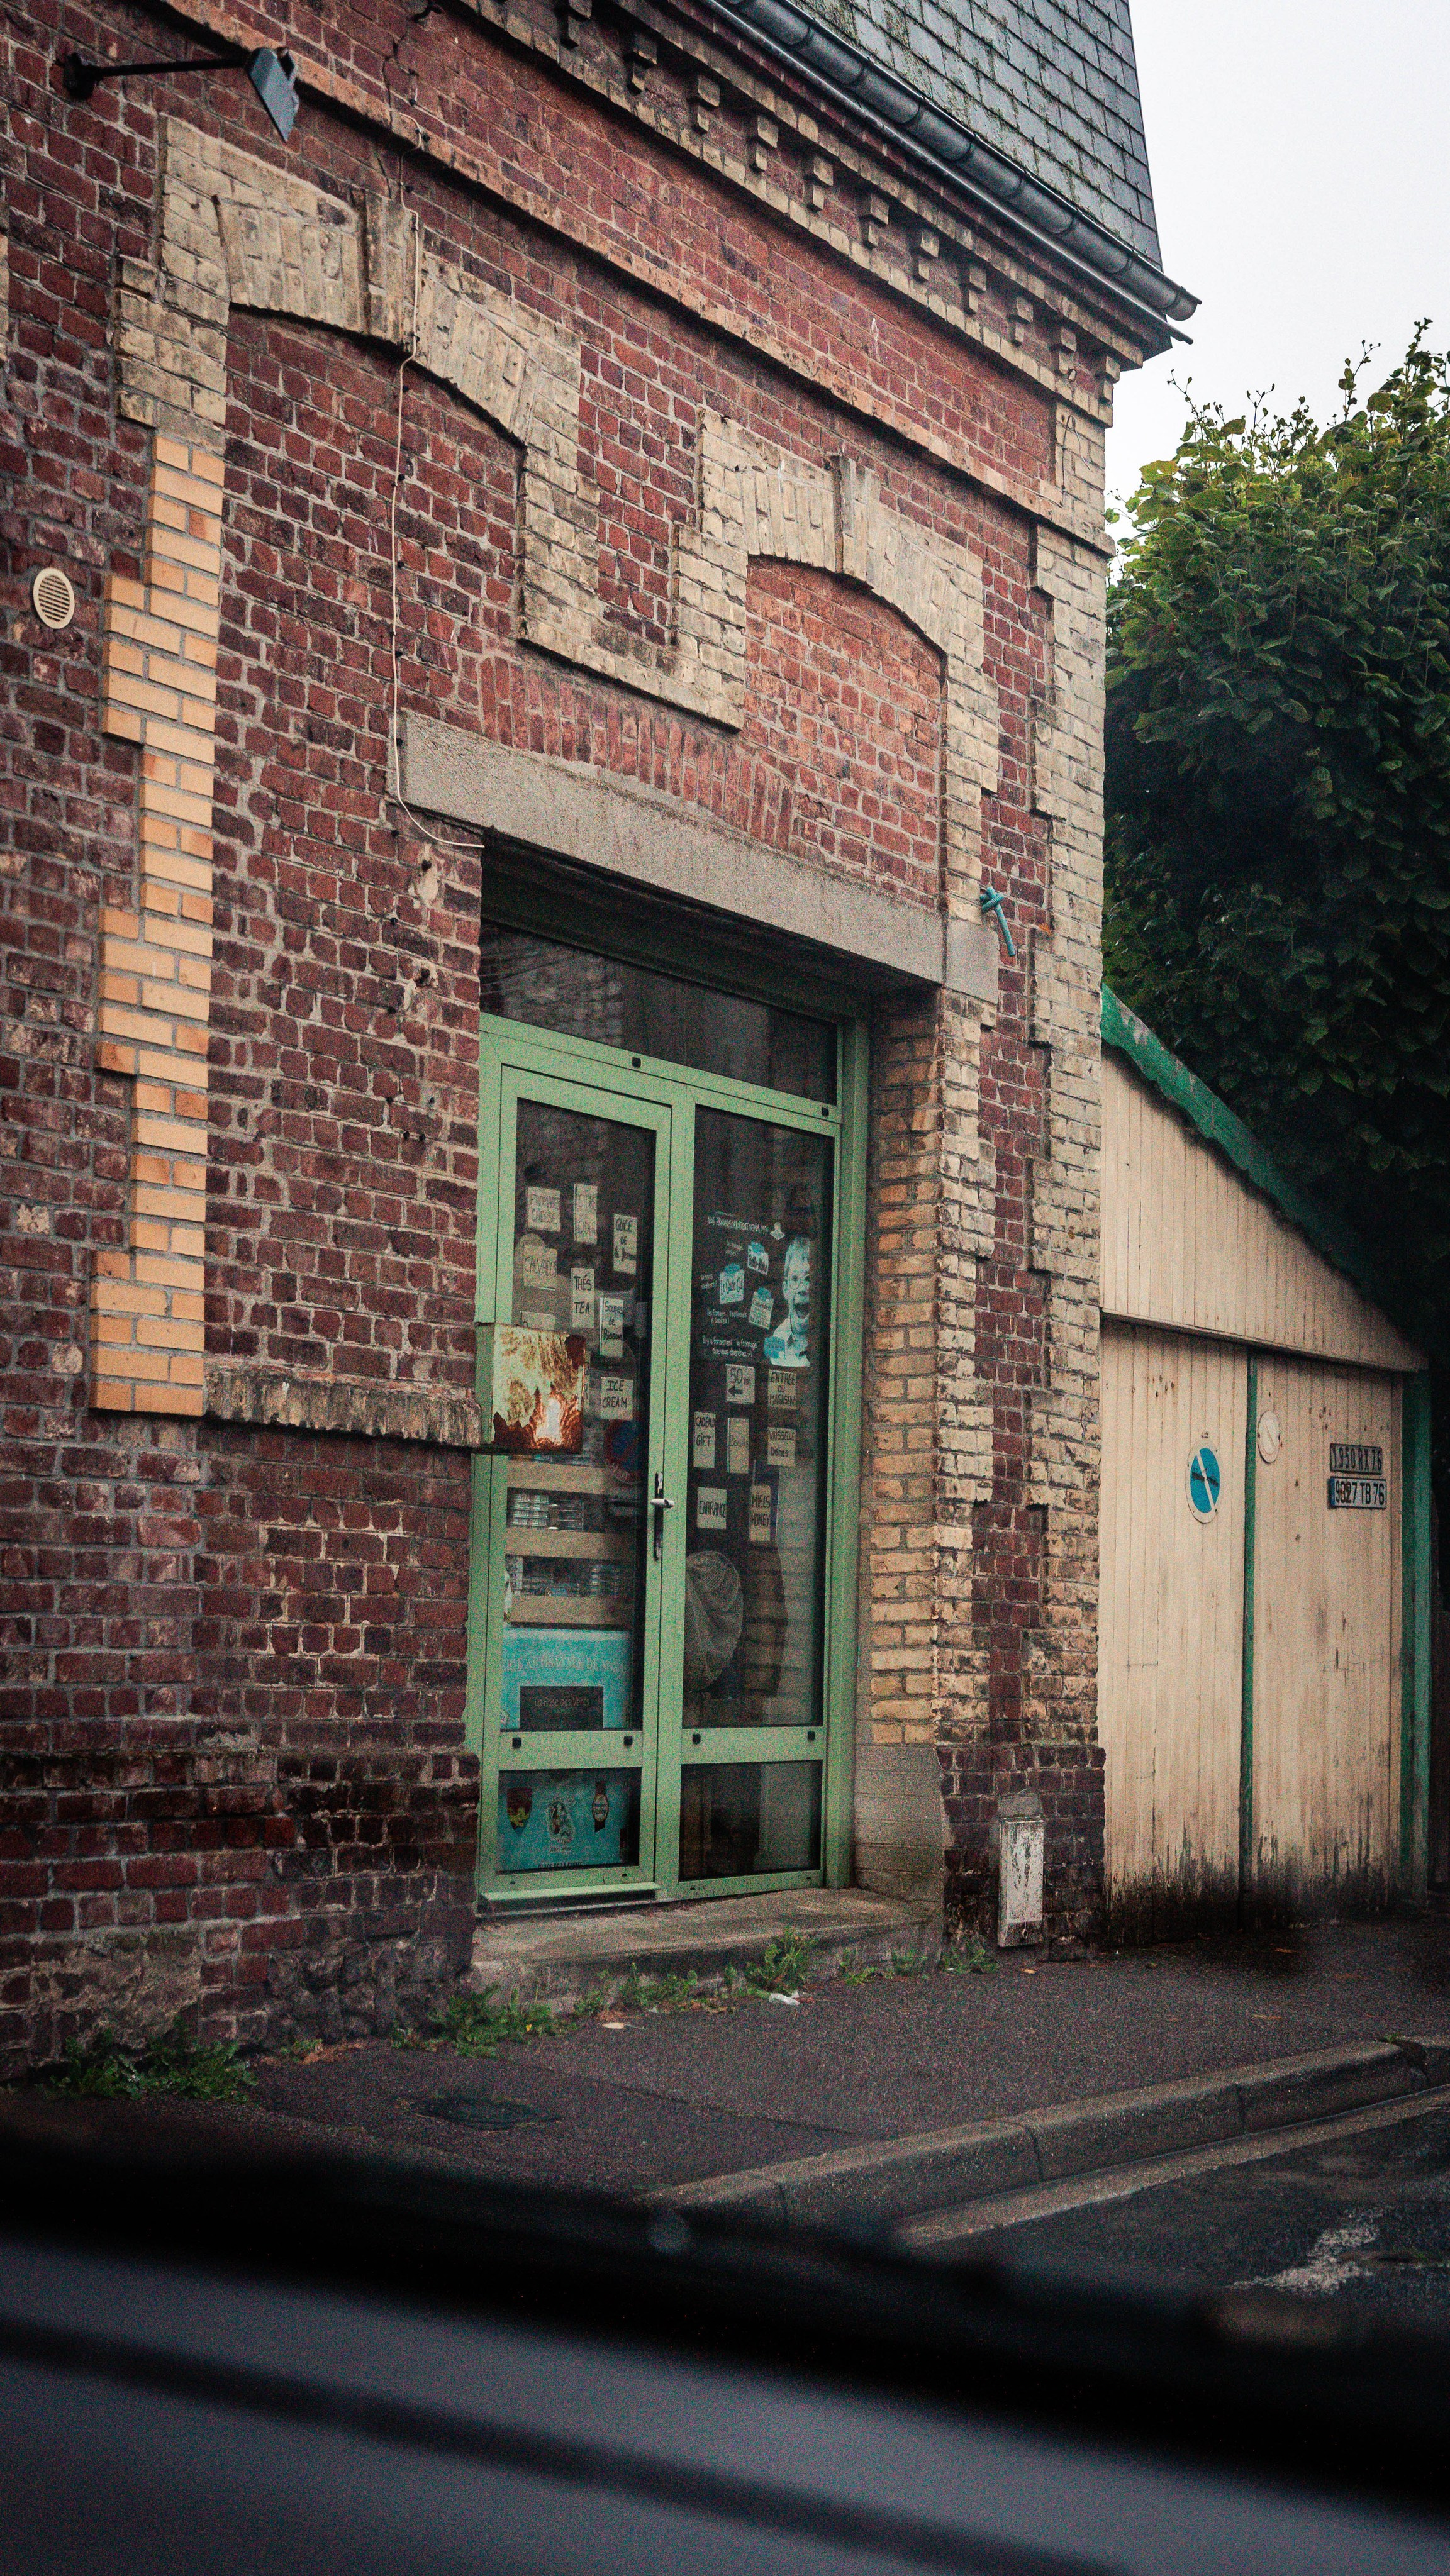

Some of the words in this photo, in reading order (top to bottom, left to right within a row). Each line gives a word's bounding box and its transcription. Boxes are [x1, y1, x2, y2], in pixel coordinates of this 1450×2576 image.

[573, 1274, 592, 1291] THÉS
[574, 1301, 590, 1314] TEA
[730, 1367, 743, 1384] 50
[606, 1380, 625, 1392] ICE
[602, 1396, 628, 1409] CREAM
[1360, 1482, 1371, 1504] TB
[1373, 1483, 1384, 1506] 76
[751, 1513, 770, 1528] HONEY
